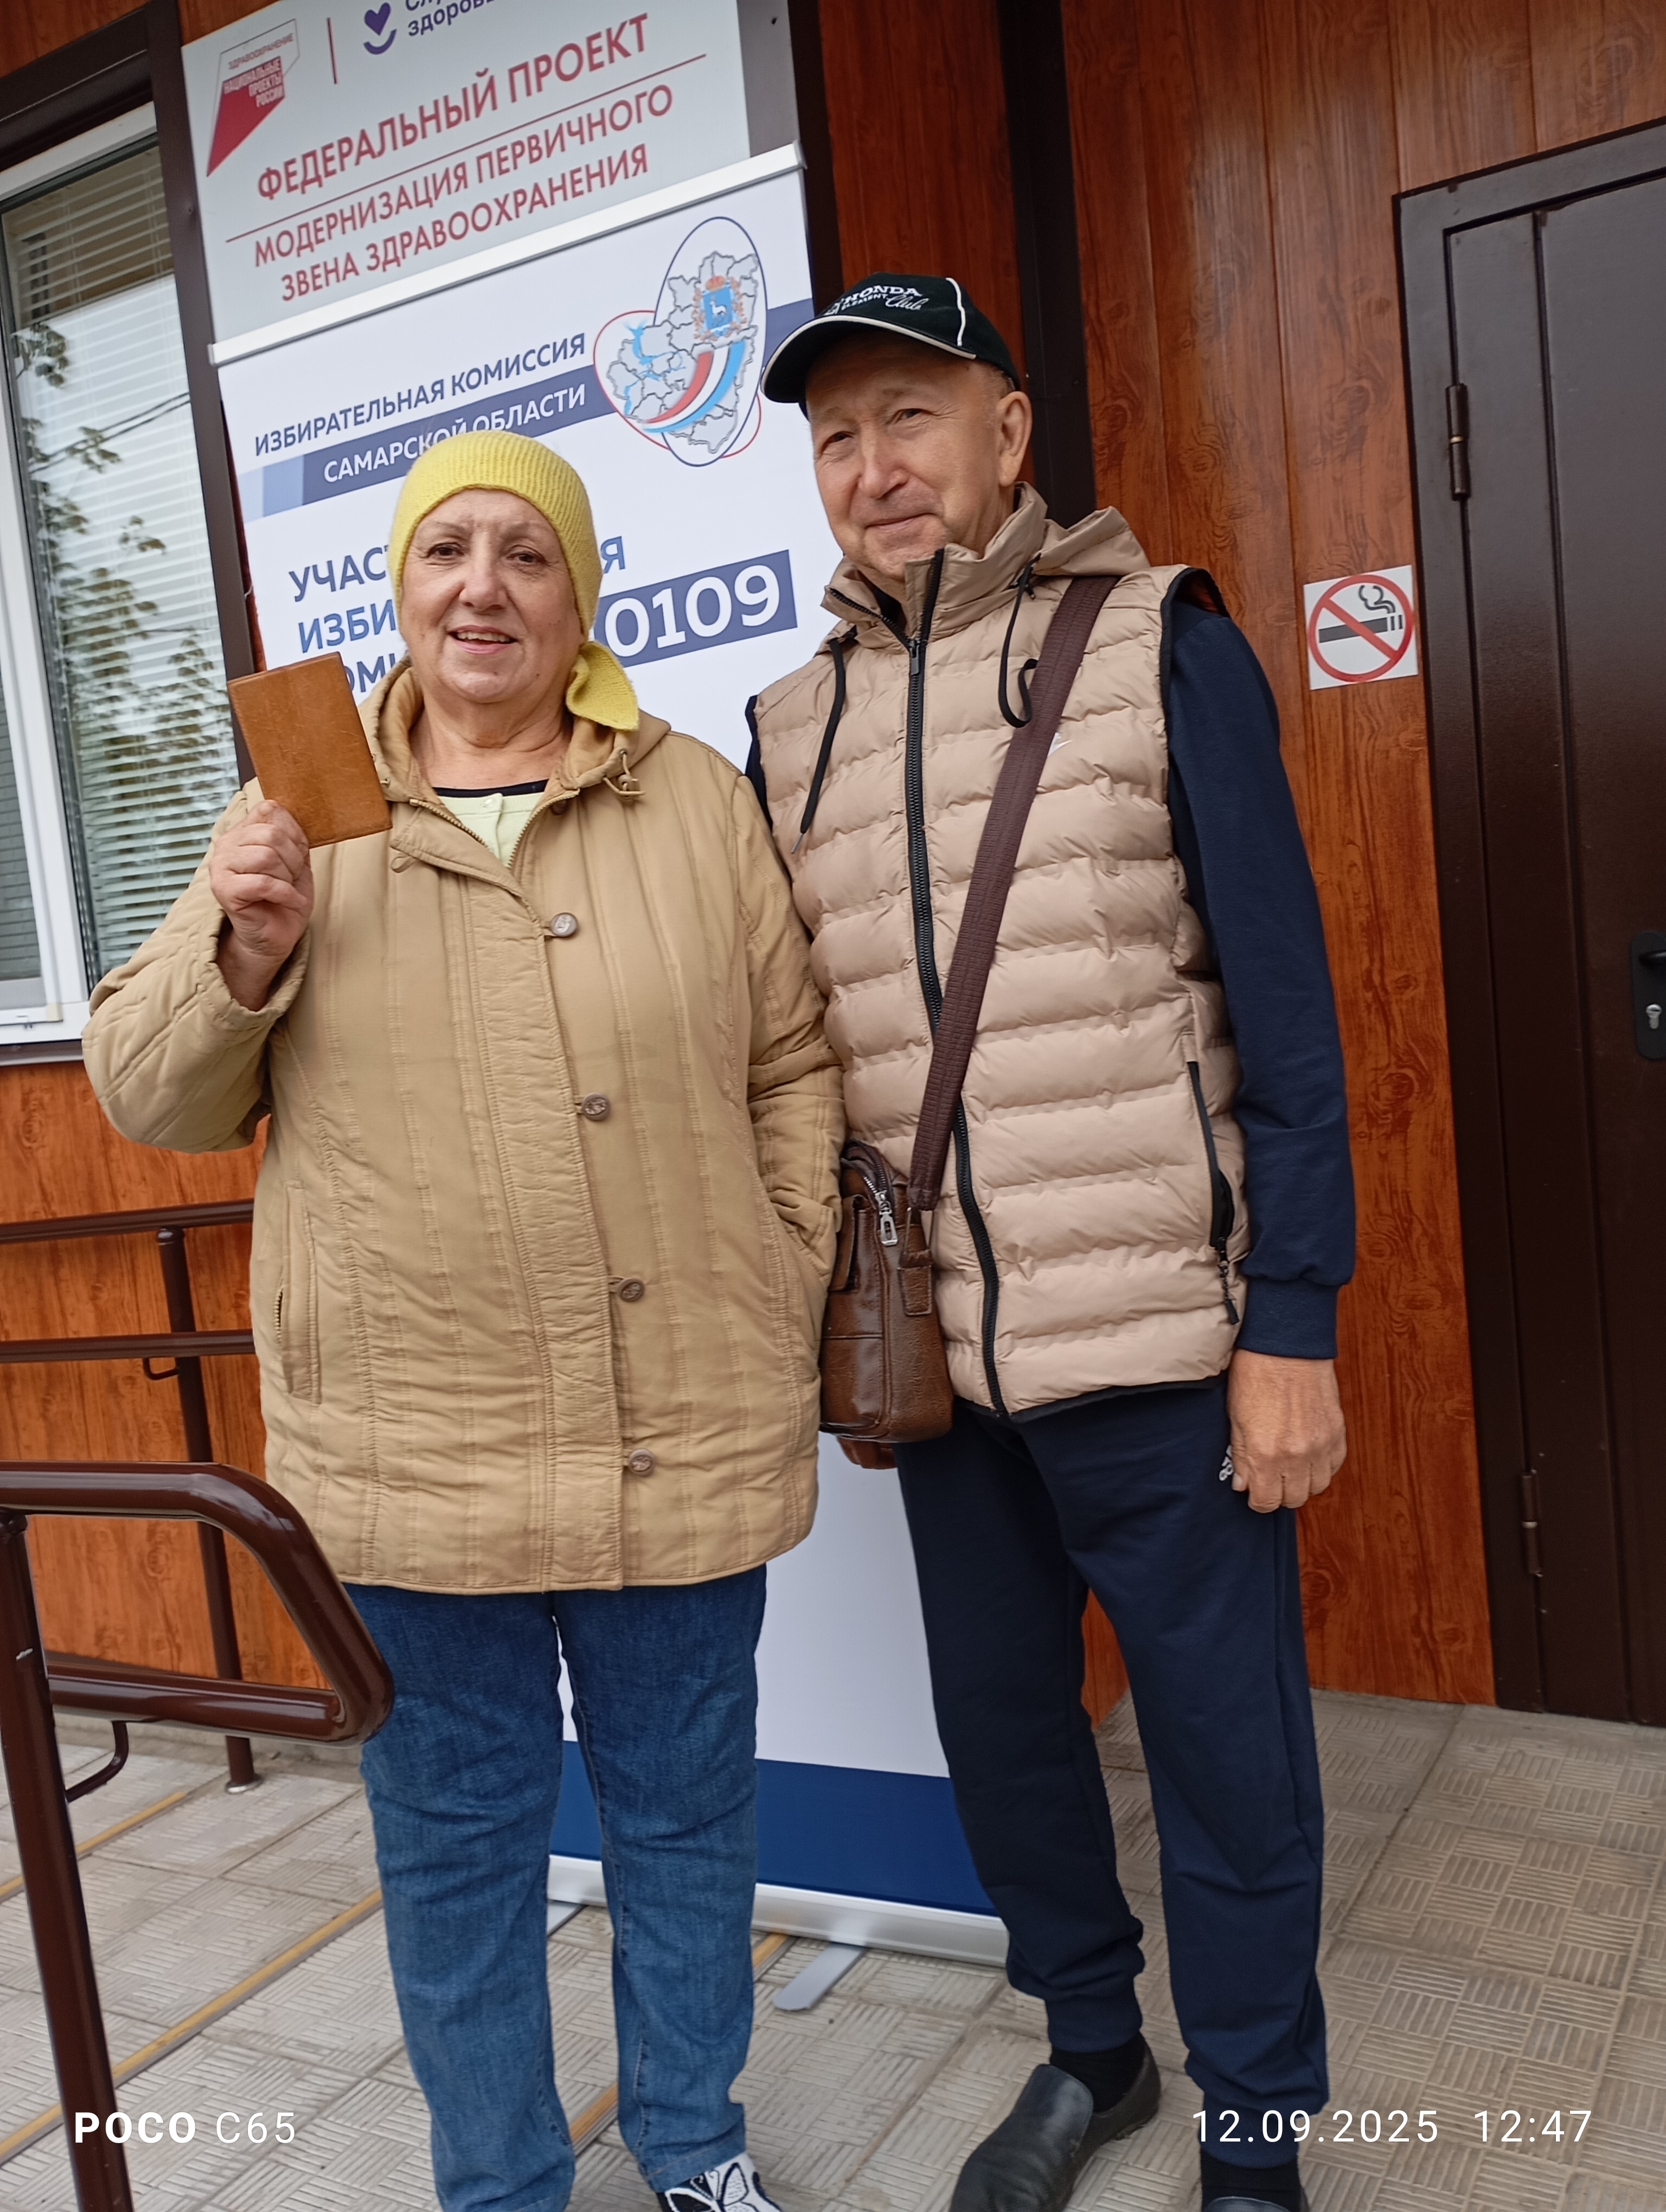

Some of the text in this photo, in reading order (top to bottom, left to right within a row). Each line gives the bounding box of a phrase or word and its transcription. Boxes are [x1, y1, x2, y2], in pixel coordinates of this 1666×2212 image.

[408, 0, 495, 36] здоро
[258, 12, 648, 200] ФЕДЕРАЛЬНЫЙ ПРОЕКТ
[255, 84, 672, 268] МОДЕРНИЗАЦИЯ ПЕРВИЧНОГО
[281, 143, 648, 302] ЗВЕНА ЗДРАВООХРАНЕНИЯ
[841, 285, 923, 305] HONDA
[885, 294, 930, 311] Club
[255, 332, 585, 456] ИЗБИРАТЕЛЬНАЯ КОМИССИЯ
[472, 384, 586, 430] ОБЛАСТИ
[288, 544, 389, 602] УЧАС
[604, 564, 780, 657] 0109
